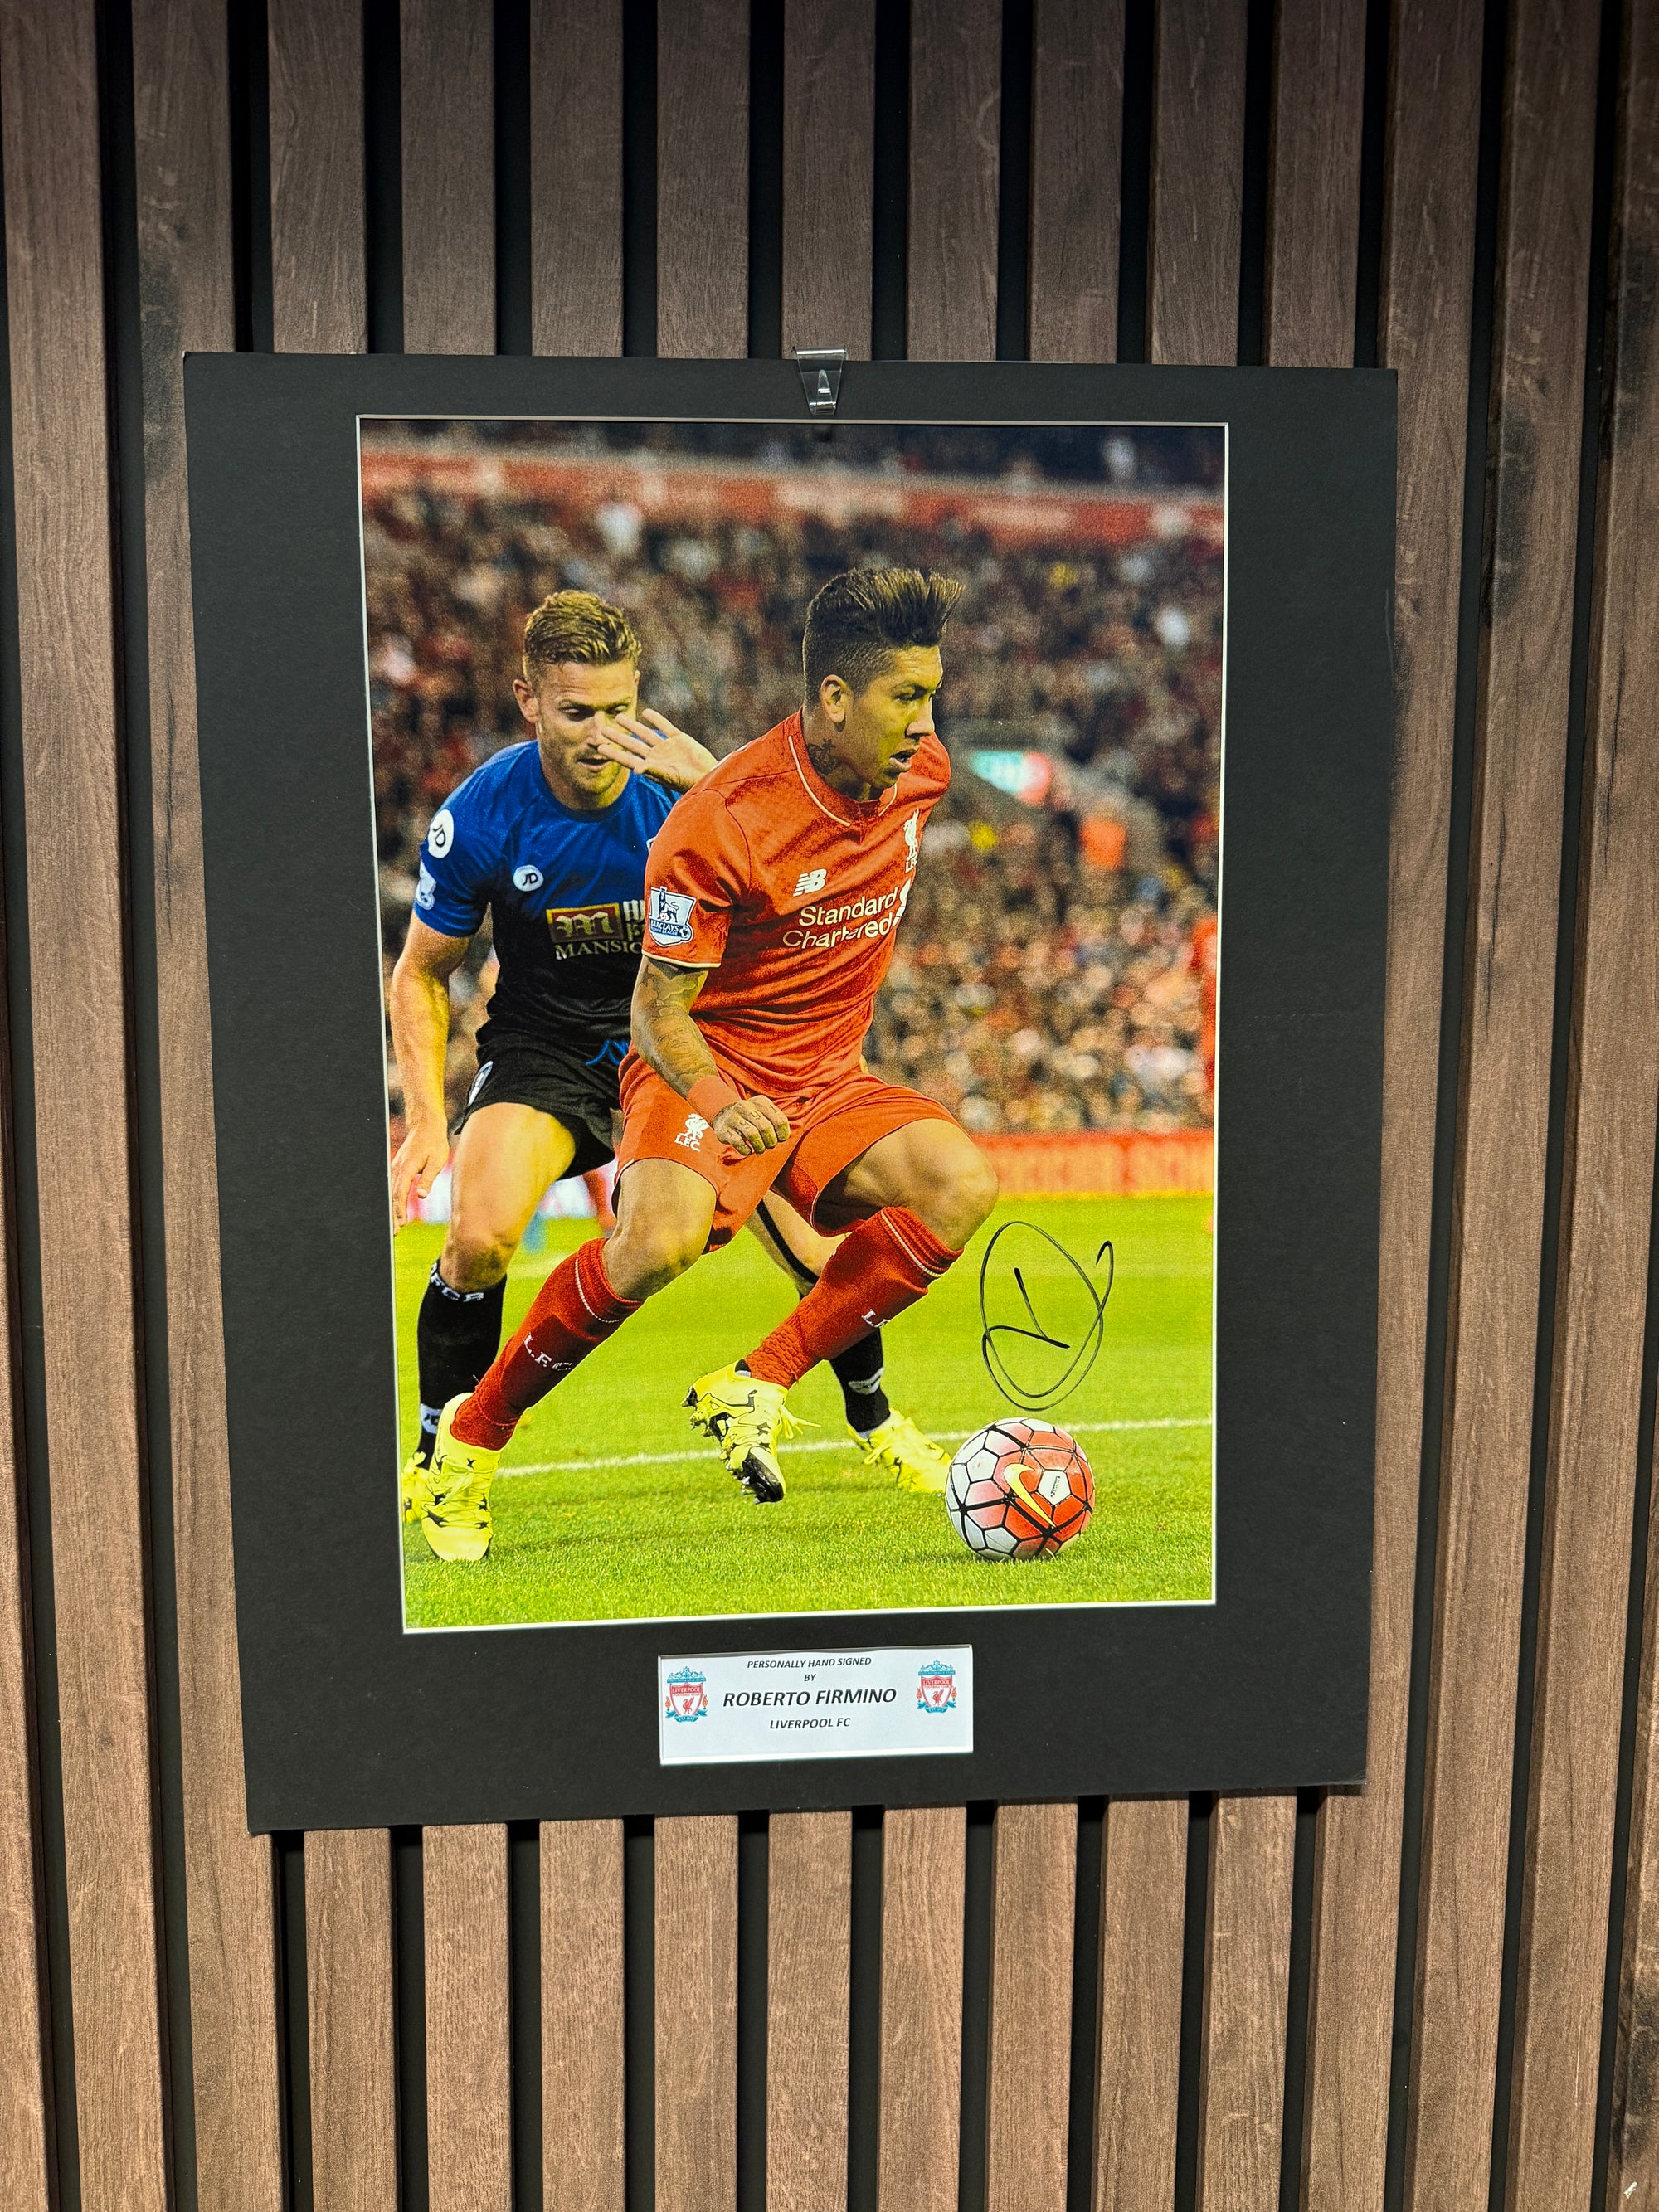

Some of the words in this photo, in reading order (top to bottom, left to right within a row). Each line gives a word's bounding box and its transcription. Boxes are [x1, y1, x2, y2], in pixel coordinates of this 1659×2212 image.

[523, 873, 538, 887] JD
[799, 887, 898, 926] Standard
[650, 920, 679, 931] BARCLAYS
[782, 912, 893, 949] Chartered
[747, 1660, 806, 1669] PERSONALLY
[808, 1659, 835, 1667] HAND
[837, 1657, 872, 1666] SIGNED
[804, 1674, 816, 1682] BY
[723, 1691, 810, 1707] ROBERTO
[815, 1689, 897, 1704] FIRMINO
[770, 1719, 834, 1729] LIVERPOOL
[836, 1718, 851, 1727] FC
